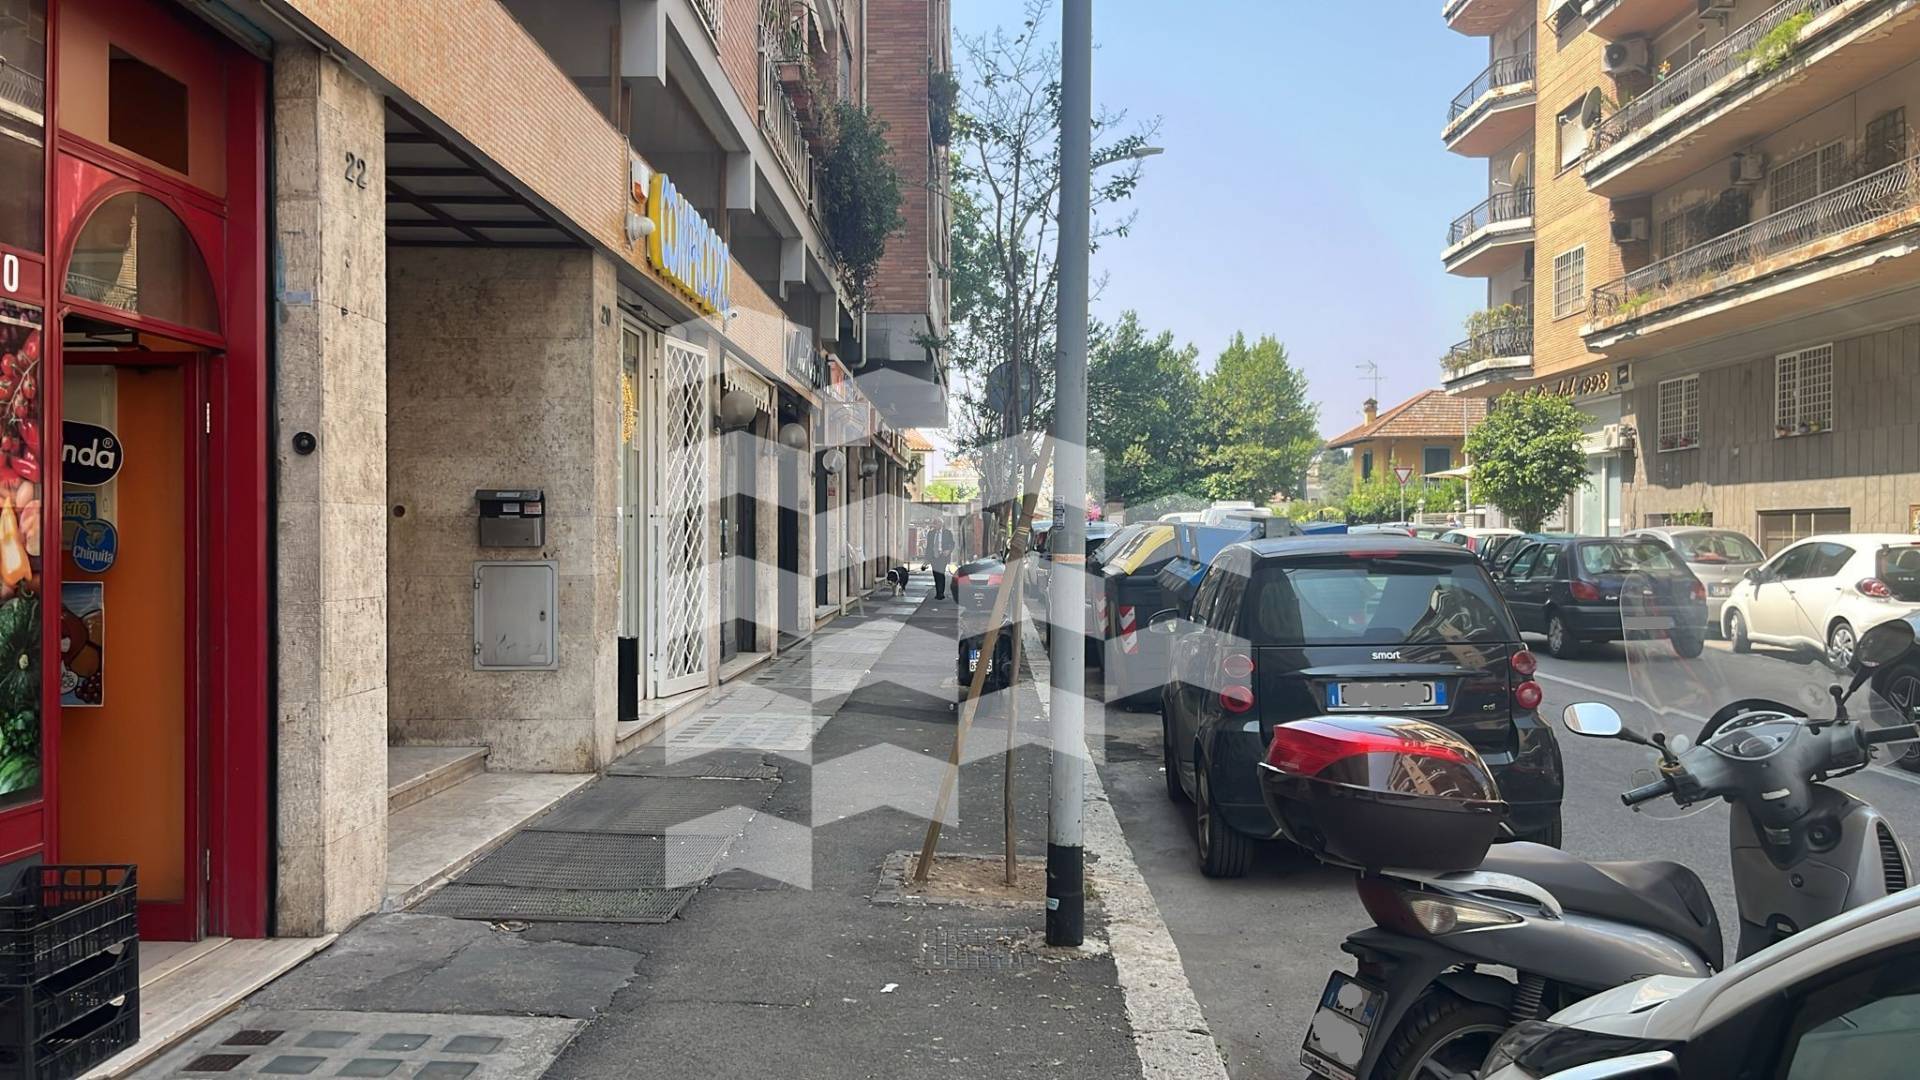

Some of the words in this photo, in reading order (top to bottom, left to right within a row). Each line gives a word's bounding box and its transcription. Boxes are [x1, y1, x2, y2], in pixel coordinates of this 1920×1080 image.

[344, 151, 367, 190] 22
[1577, 370, 1610, 396] 1998
[62, 438, 115, 470] nda
[64, 501, 91, 518] HIQ
[73, 545, 114, 565] Chiquita
[1371, 651, 1401, 660] smart
